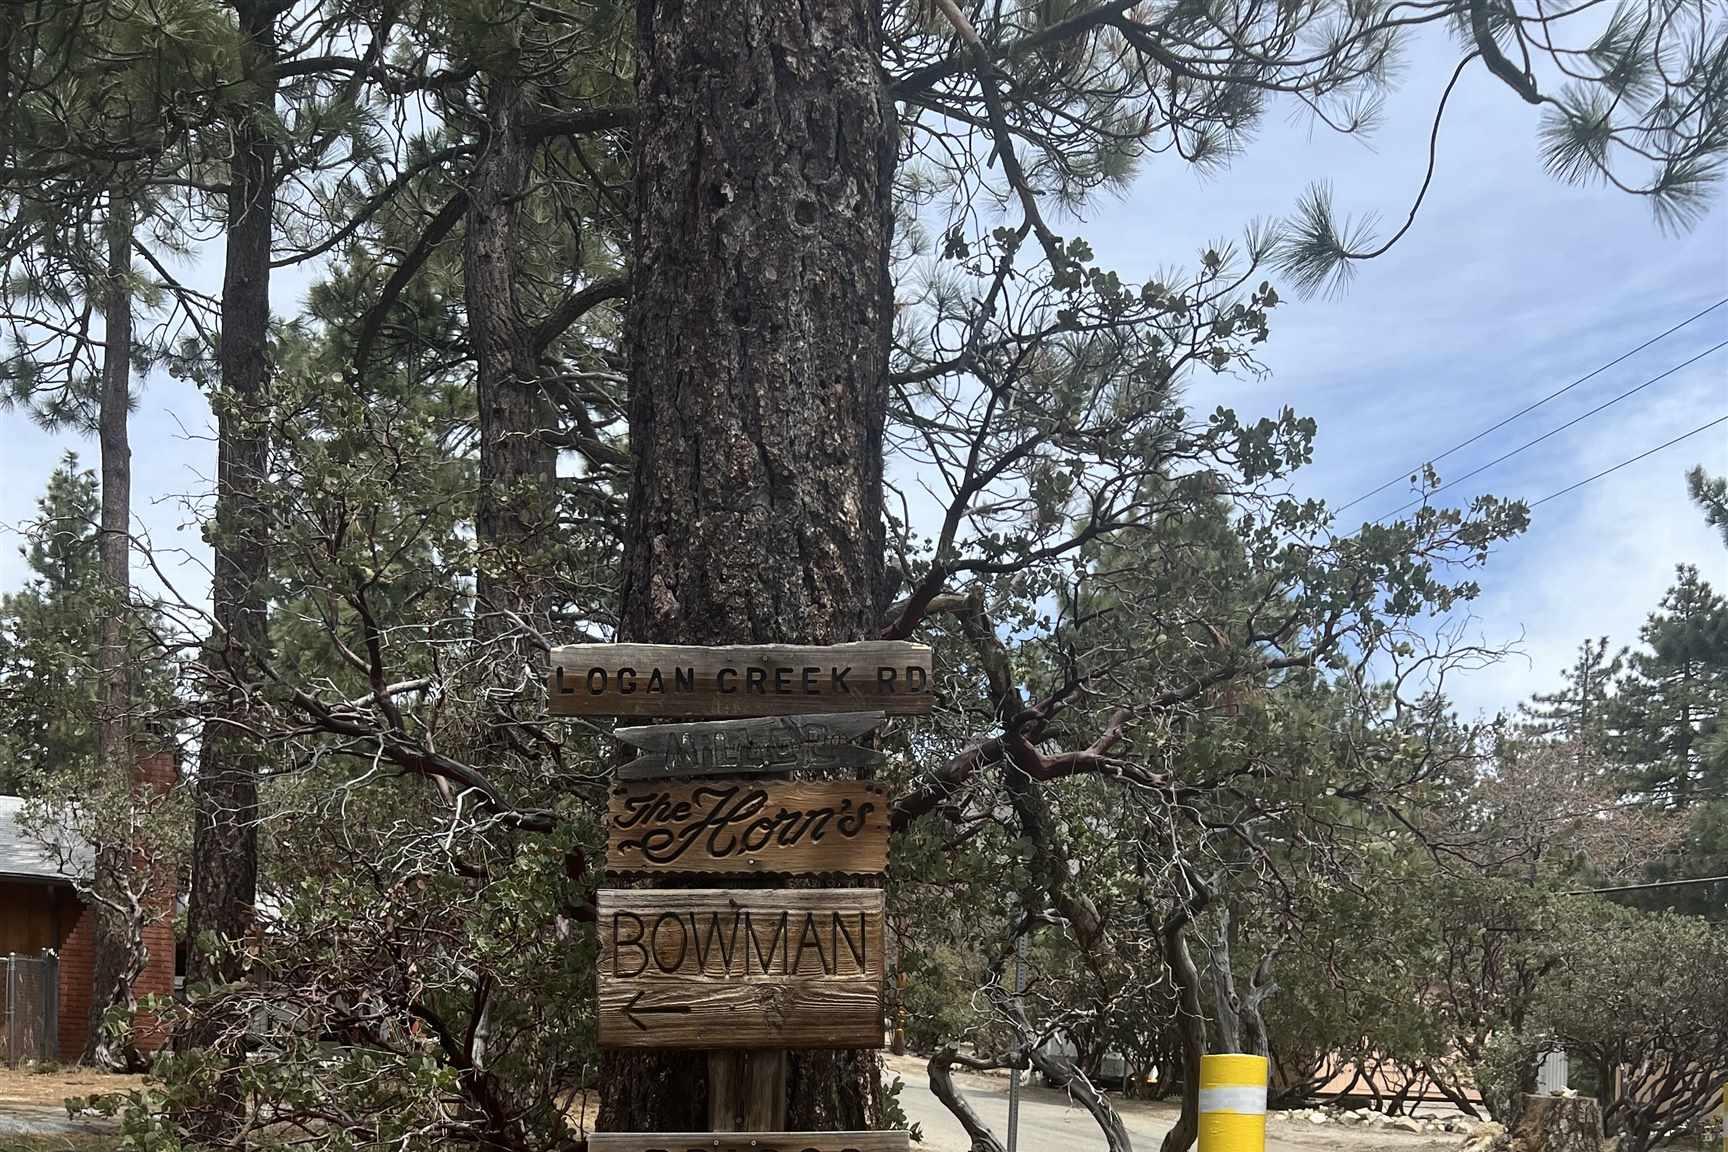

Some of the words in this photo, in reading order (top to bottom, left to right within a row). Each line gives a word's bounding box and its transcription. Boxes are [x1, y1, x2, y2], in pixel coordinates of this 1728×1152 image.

[556, 666, 694, 696] LOGAN
[716, 666, 853, 696] CREEK
[613, 792, 692, 829] The
[617, 785, 875, 864] Horn's
[612, 911, 866, 978] BOWMAN
